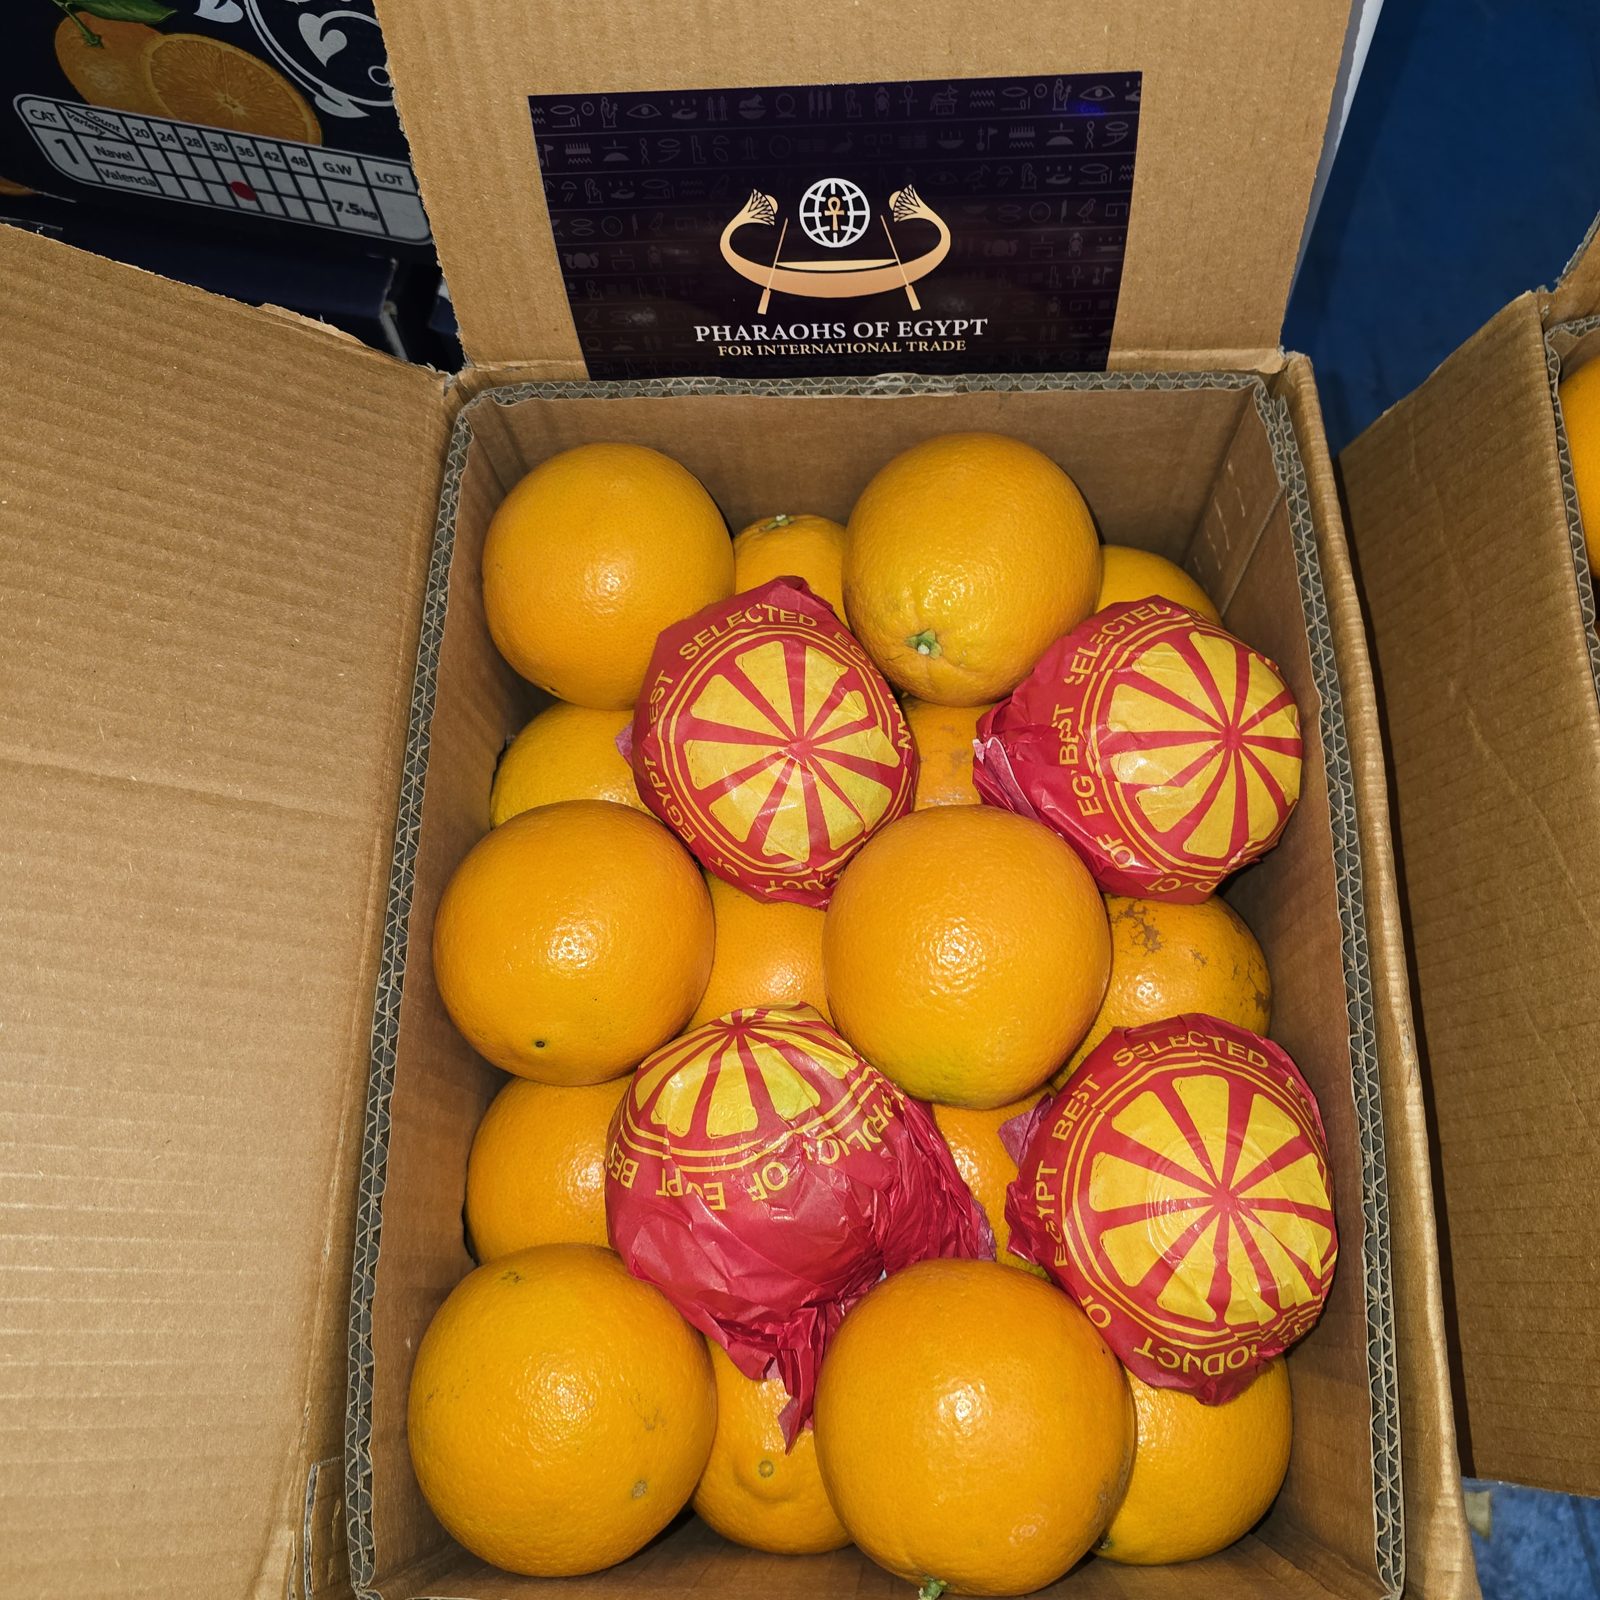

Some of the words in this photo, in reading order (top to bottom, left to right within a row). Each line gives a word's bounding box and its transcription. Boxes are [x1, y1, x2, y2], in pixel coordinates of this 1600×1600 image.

[29, 109, 57, 123] CAT
[66, 111, 106, 139] Variety
[85, 110, 121, 133] Count
[94, 145, 135, 162] Navel
[132, 127, 150, 139] 20
[157, 131, 176, 144] 24
[184, 136, 203, 149] 28
[210, 141, 229, 153] 30
[237, 145, 256, 158] 36
[263, 150, 282, 163] 42
[290, 155, 309, 168] 48
[99, 167, 158, 187] Valencia
[322, 161, 352, 177] G.W
[375, 171, 404, 186] LOT
[693, 322, 847, 342] PHARAOHS
[852, 321, 890, 339] OF
[896, 318, 988, 338] EGYPT
[718, 345, 754, 356] FOR
[757, 341, 903, 356] INTERNATIONAL
[905, 340, 967, 352] TRADE
[678, 602, 818, 661] SELECTED
[649, 670, 674, 725] EST
[643, 756, 697, 844] EGYPT
[1096, 831, 1136, 869] OF
[1112, 1030, 1269, 1070] SELECTED
[1051, 1073, 1101, 1141] BEST
[608, 1142, 640, 1189] BES
[747, 1161, 790, 1202] OF
[1035, 1160, 1068, 1268] EGYPT
[1133, 1336, 1258, 1377] ODUCT
